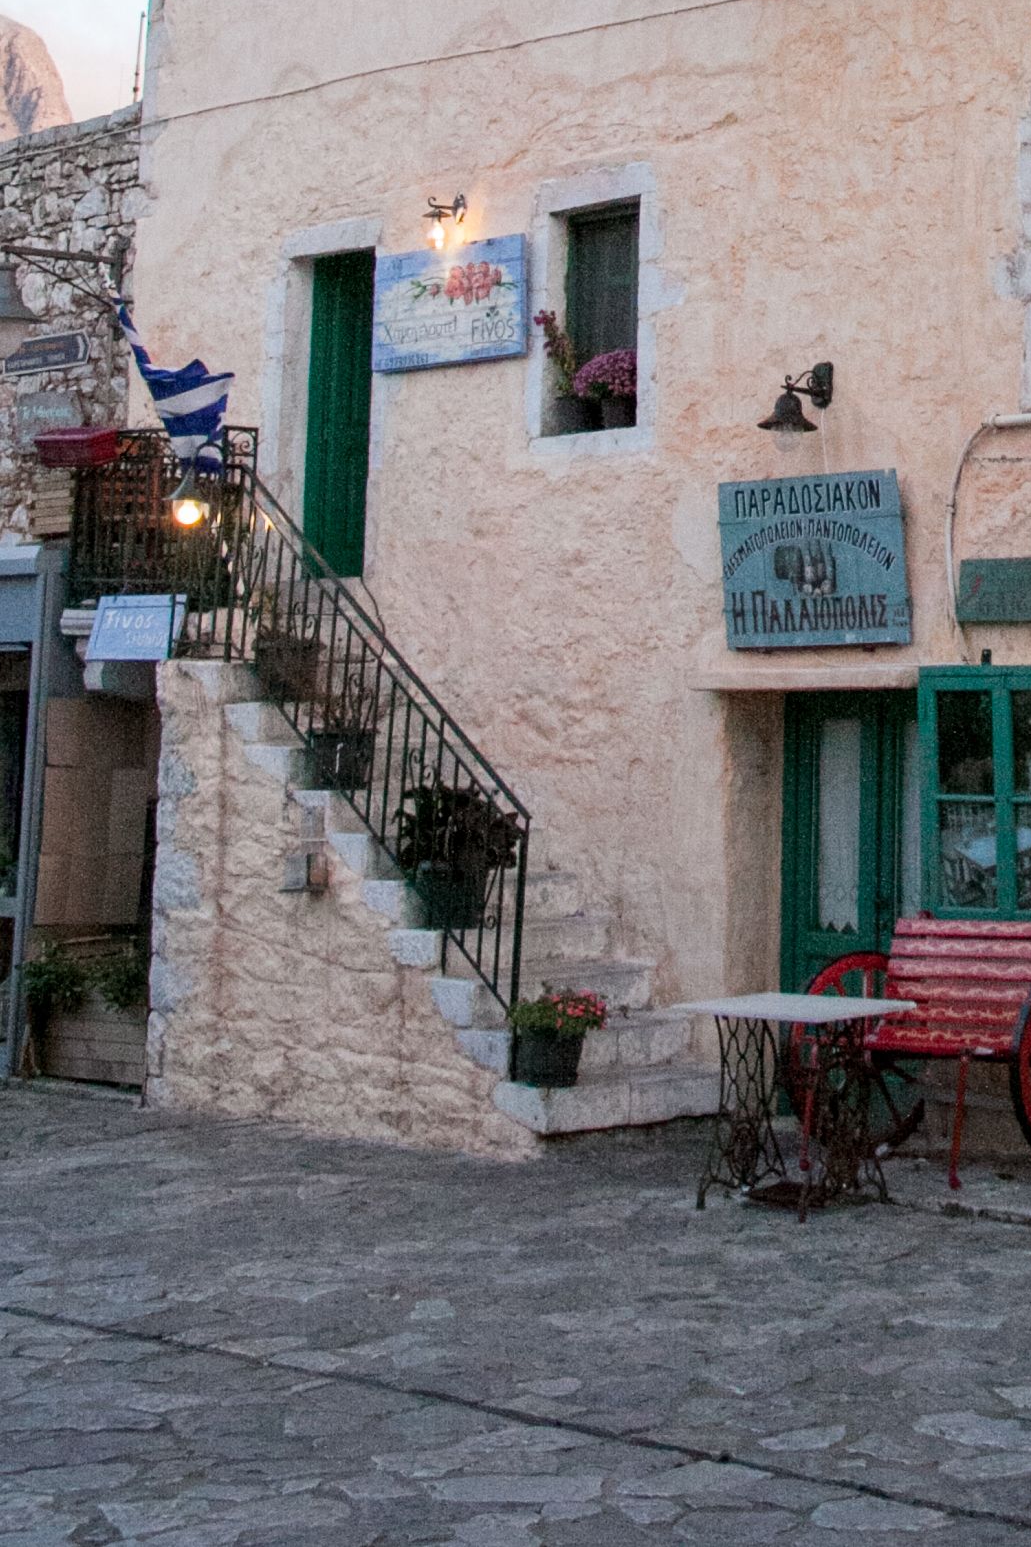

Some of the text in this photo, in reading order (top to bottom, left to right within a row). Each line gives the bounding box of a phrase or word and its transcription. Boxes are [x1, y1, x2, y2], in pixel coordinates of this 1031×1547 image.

[735, 479, 881, 519] ΠΑΡΑΔΟΣΙΑΚΟΝ
[731, 592, 747, 634] Η
[752, 590, 888, 634] ΠΑΛΑΙΟΠΟΛΙΣ
